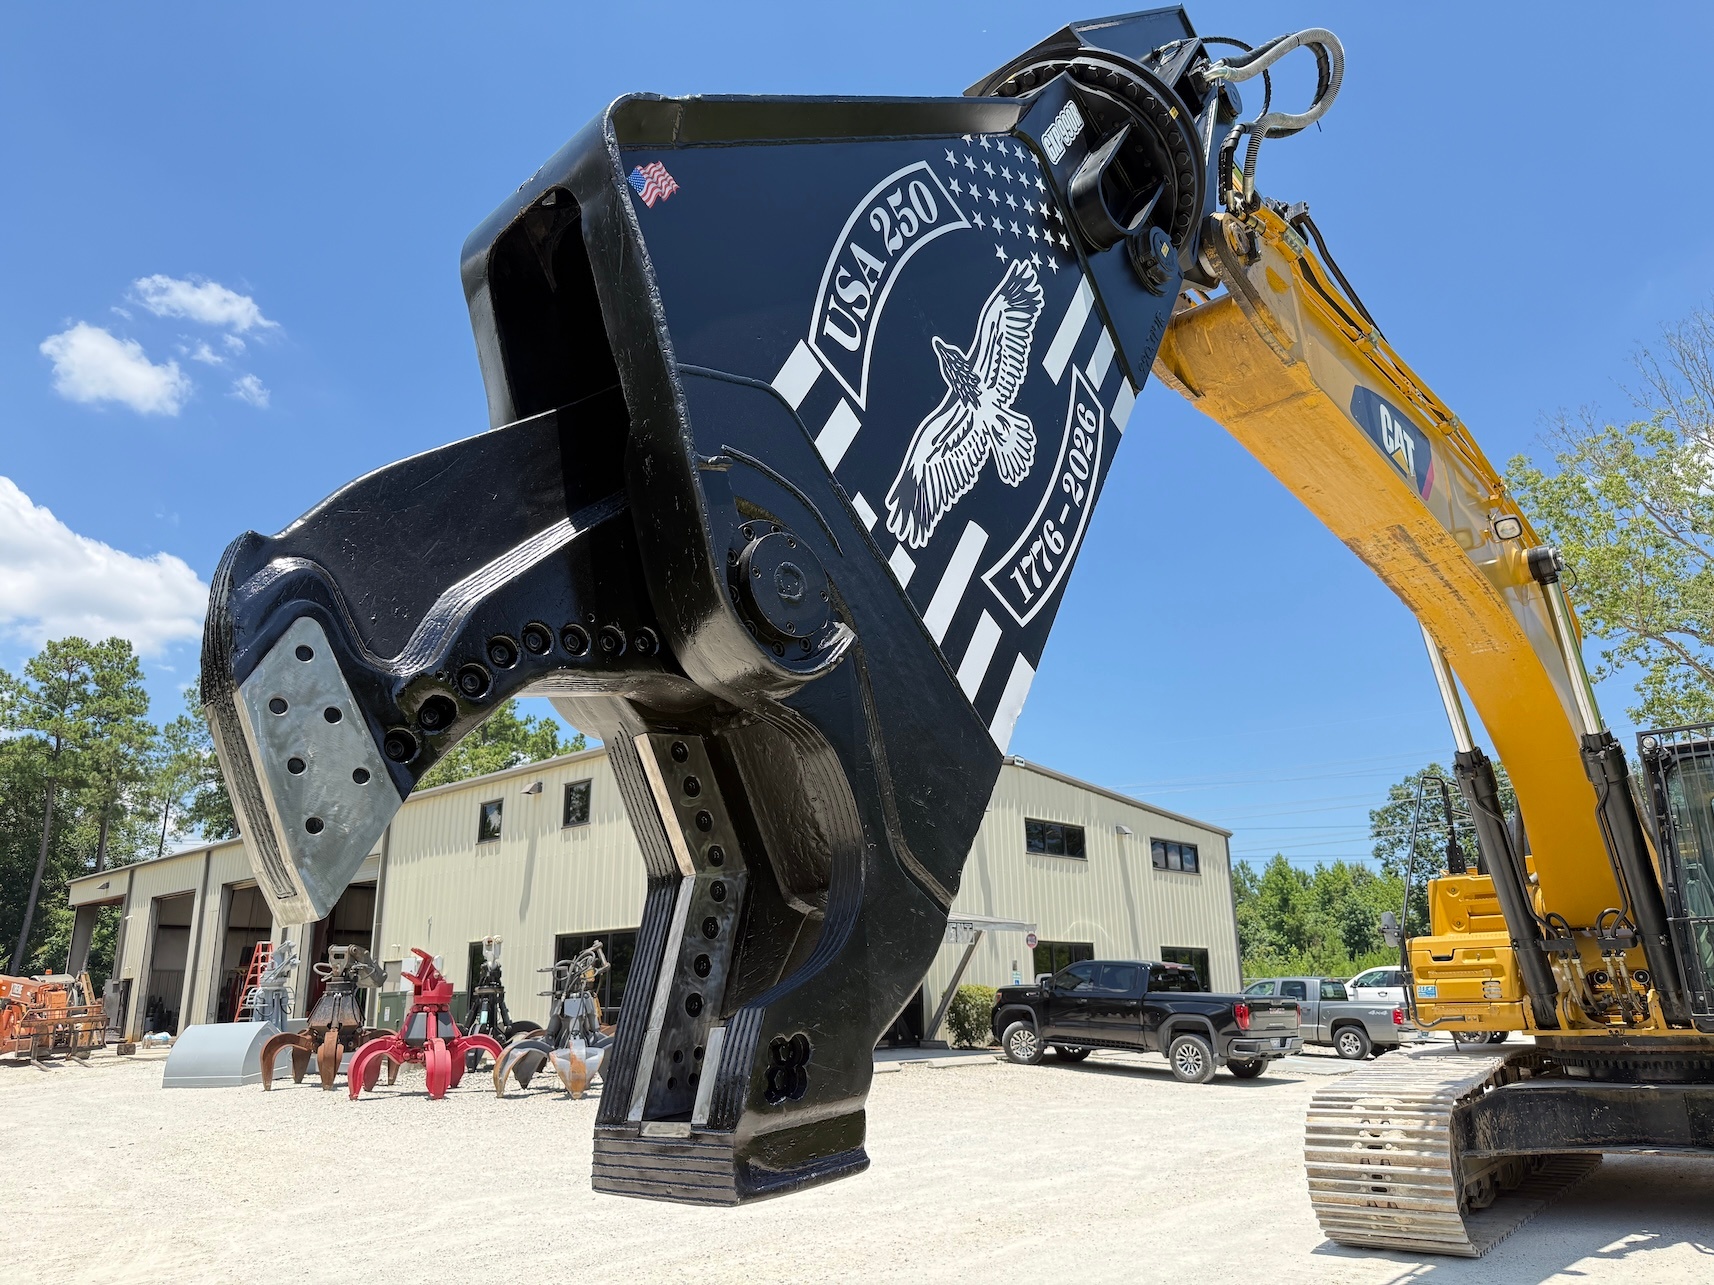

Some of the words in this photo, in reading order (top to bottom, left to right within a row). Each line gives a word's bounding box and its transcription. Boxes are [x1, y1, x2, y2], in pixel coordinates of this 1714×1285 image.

[823, 242, 887, 352] USA
[869, 180, 938, 257] 250
[1379, 403, 1416, 477] CAT
